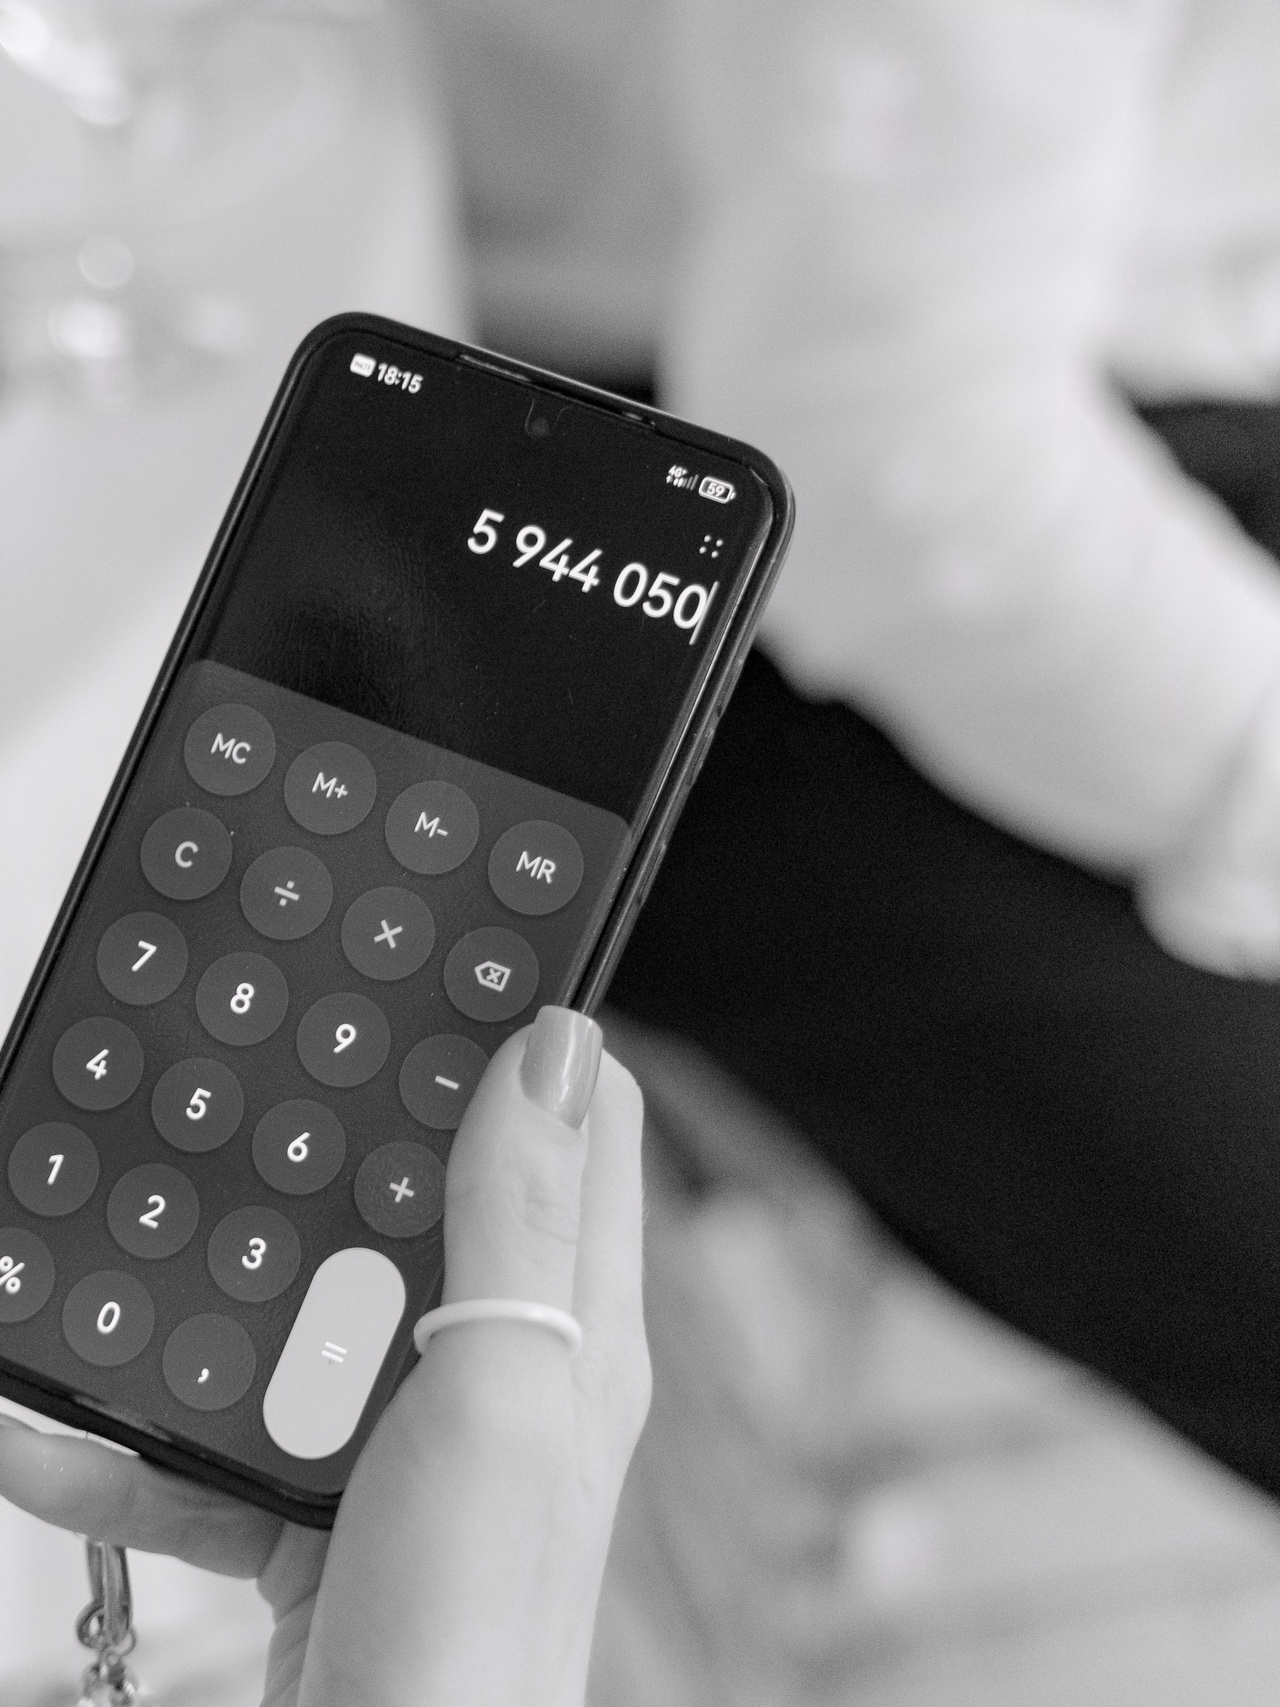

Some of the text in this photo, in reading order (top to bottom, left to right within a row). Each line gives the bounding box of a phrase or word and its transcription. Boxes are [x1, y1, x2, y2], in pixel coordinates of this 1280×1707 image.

[377, 362, 424, 394] 18:15
[706, 482, 726, 497] 59
[467, 508, 709, 630] 5 944 050
[210, 733, 251, 765] MC
[311, 772, 348, 800] M+
[174, 841, 199, 869] C
[515, 850, 556, 884] MR
[131, 940, 157, 973] 7
[230, 982, 255, 1015] 8
[333, 1023, 358, 1055] 9
[85, 1048, 109, 1080] 4
[185, 1087, 212, 1121] 5
[286, 1132, 311, 1164] 6
[46, 1154, 65, 1185] 1
[138, 1194, 166, 1229] 2
[241, 1237, 267, 1270] 3
[96, 1301, 121, 1334] 0
